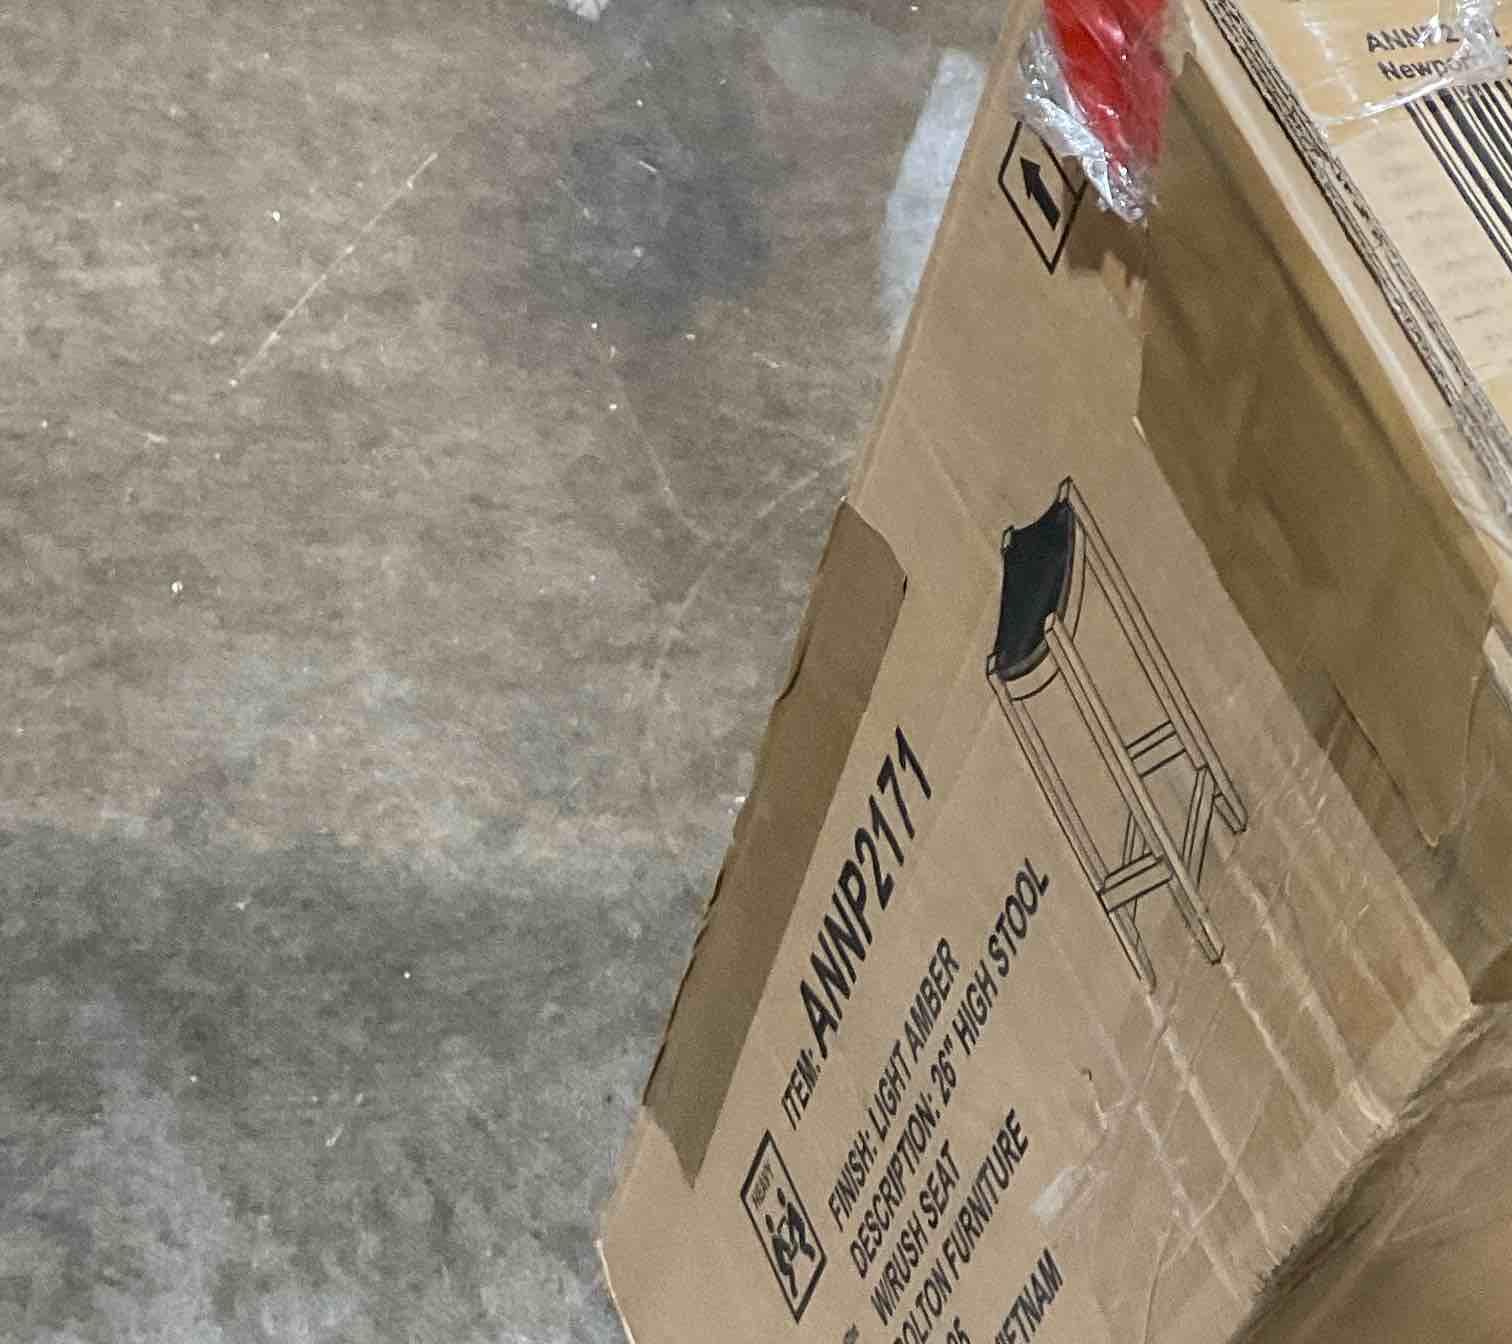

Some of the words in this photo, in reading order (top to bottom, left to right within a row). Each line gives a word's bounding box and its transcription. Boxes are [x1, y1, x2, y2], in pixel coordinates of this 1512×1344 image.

[798, 724, 933, 1061] ANNP2171
[781, 1047, 821, 1132] ITEM:
[827, 1129, 878, 1233] FINISH:
[868, 1039, 912, 1143] LIGHT
[903, 936, 961, 1065] AMBER
[848, 1091, 942, 1280] DESCRIPTION:
[930, 1032, 955, 1106] 26"
[951, 959, 999, 1057] HIGH
[987, 856, 1050, 979] STOOL
[918, 1138, 962, 1232] SEAT
[941, 1107, 1030, 1281] FURNITURE
